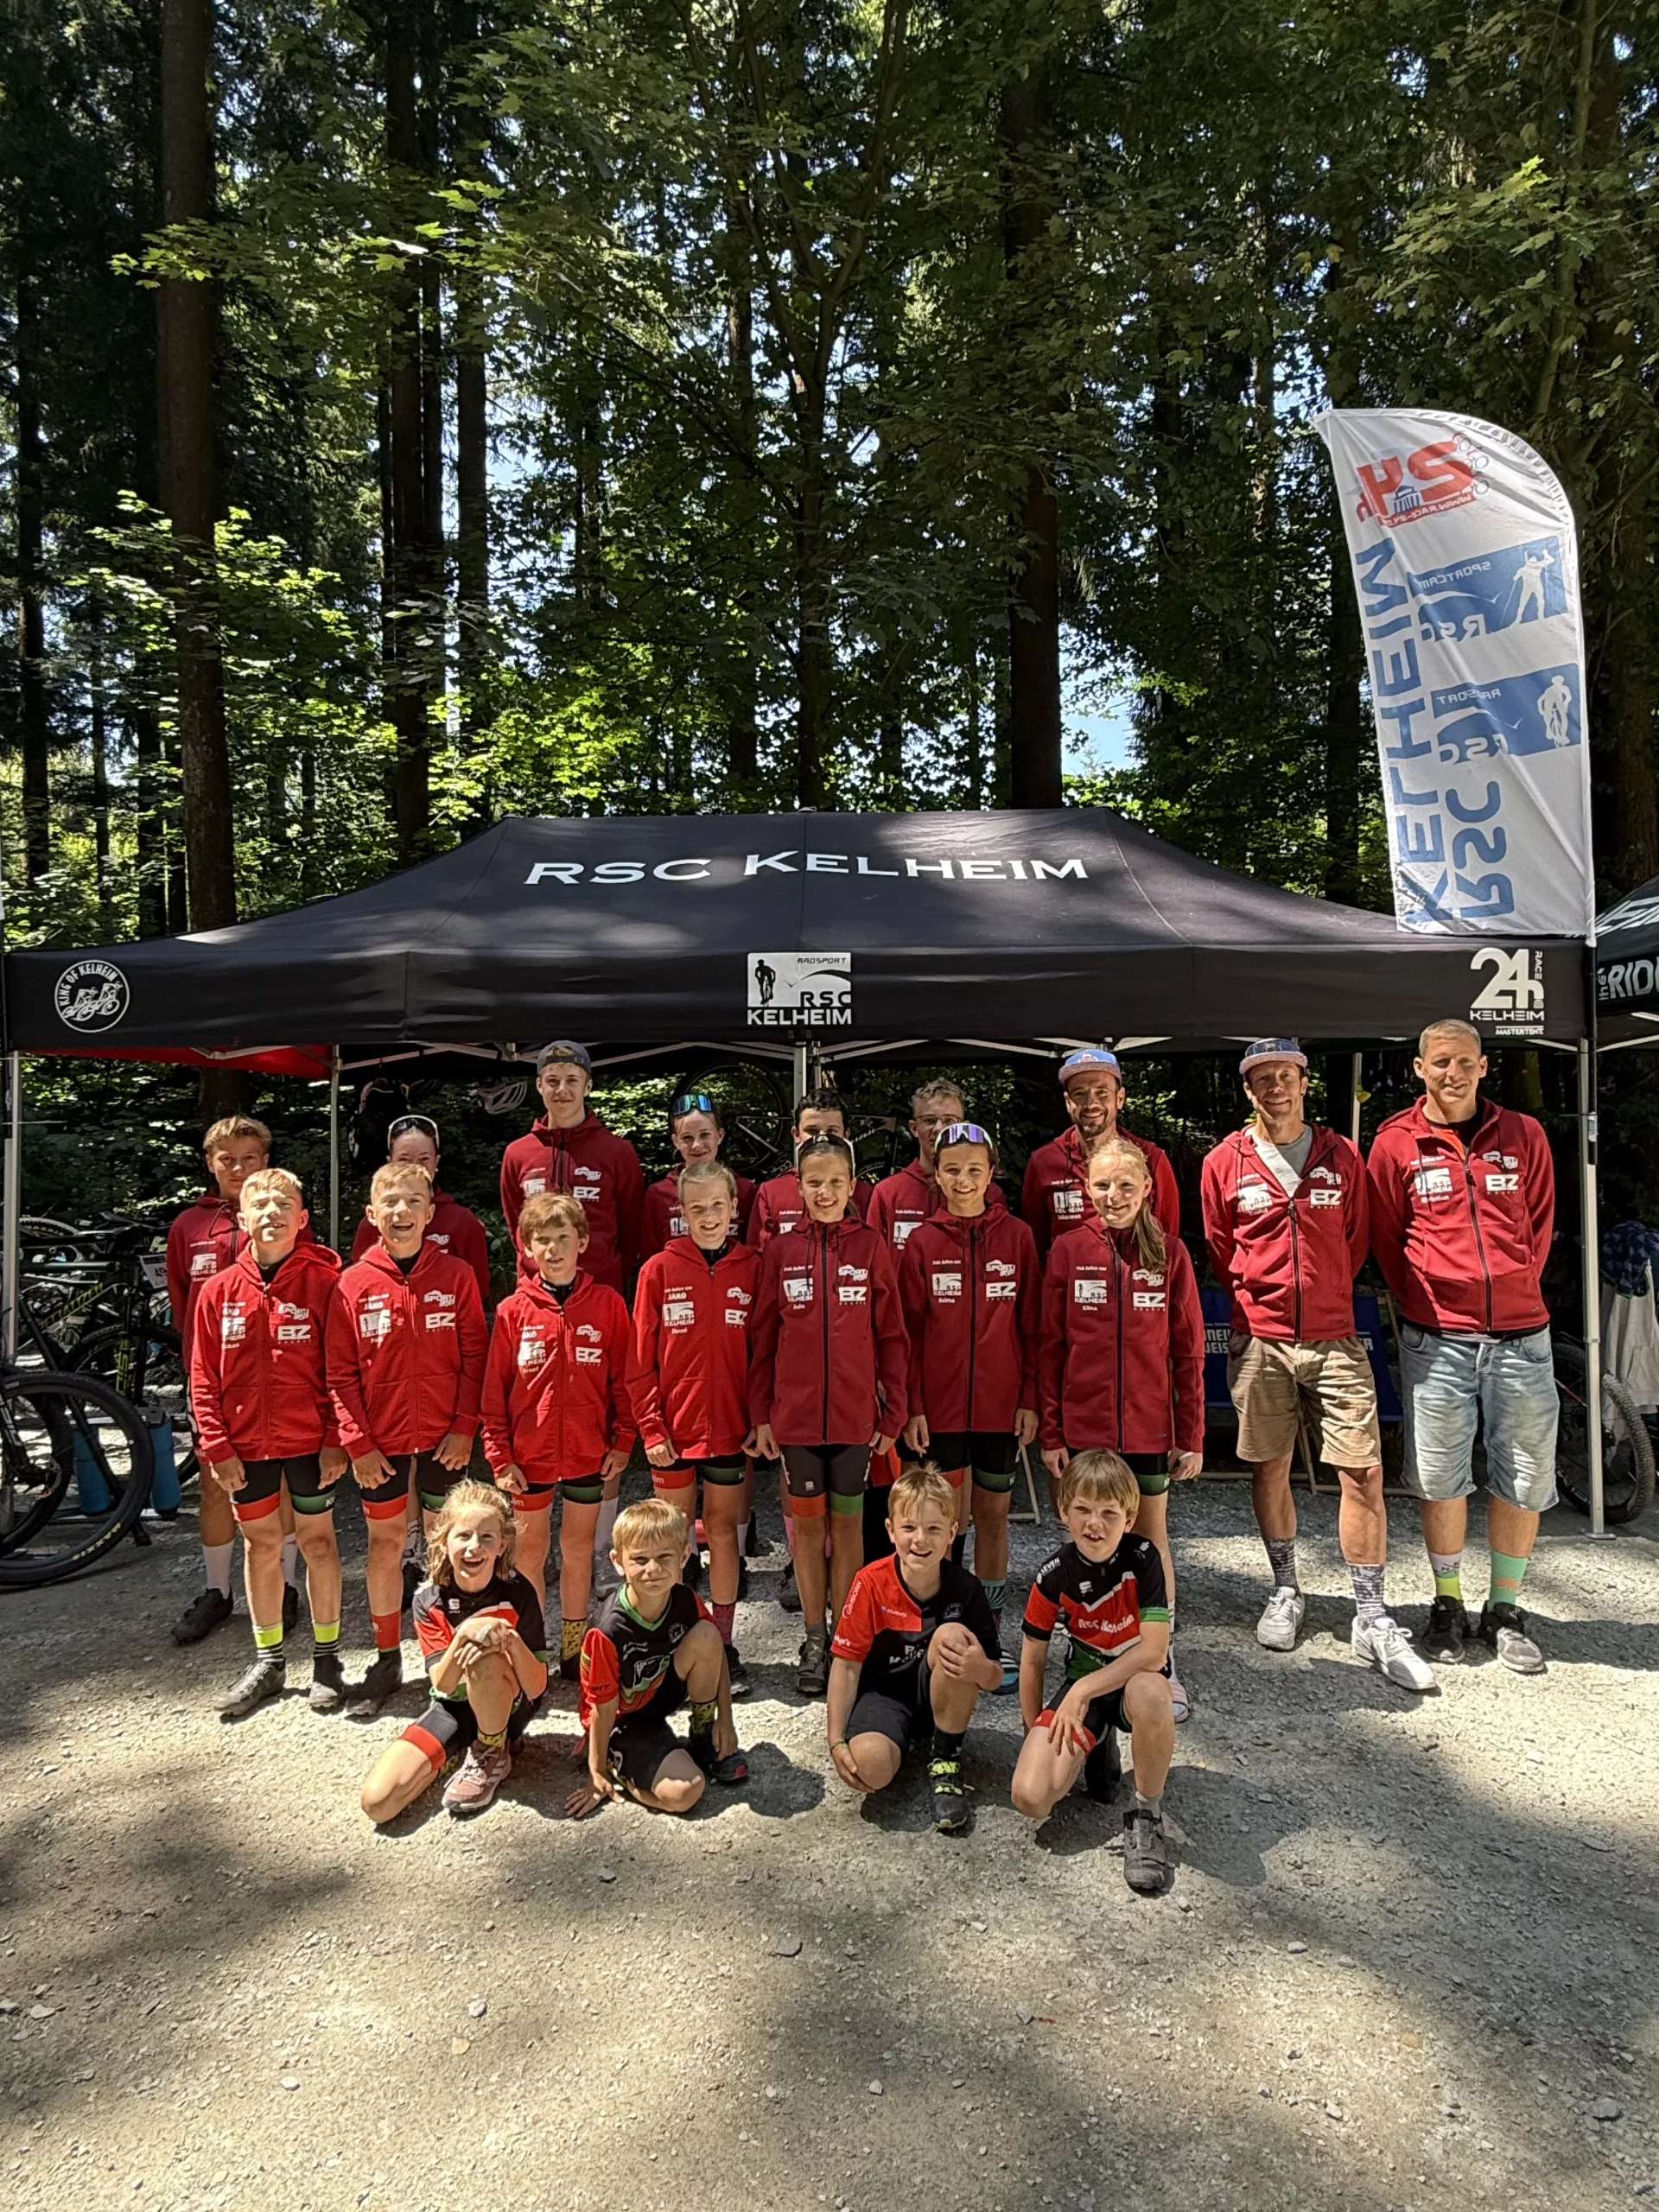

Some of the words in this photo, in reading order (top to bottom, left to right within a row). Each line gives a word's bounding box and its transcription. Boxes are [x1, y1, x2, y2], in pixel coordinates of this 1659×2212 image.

[523, 858, 712, 884] RSC
[742, 850, 1090, 880] KELHEIM
[78, 963, 118, 982] KELHEIM
[1535, 951, 1543, 980] RACE
[65, 969, 79, 983] OF
[1608, 957, 1659, 999] RID
[59, 982, 72, 1007] KING
[800, 991, 851, 1007] RSC
[747, 1009, 852, 1025] KELHEIM
[1470, 1010, 1545, 1020] KELHEIM
[1485, 1174, 1519, 1192] BZ
[573, 1186, 601, 1199] BZ
[1310, 1189, 1342, 1205] BZ
[838, 1287, 868, 1301] BZ
[986, 1282, 1016, 1298] BZ
[1133, 1292, 1166, 1307] BZ
[425, 1313, 456, 1329] BZ
[277, 1325, 312, 1340] BZ
[575, 1347, 602, 1363] BZ
[1040, 1556, 1061, 1575] SEVEN
